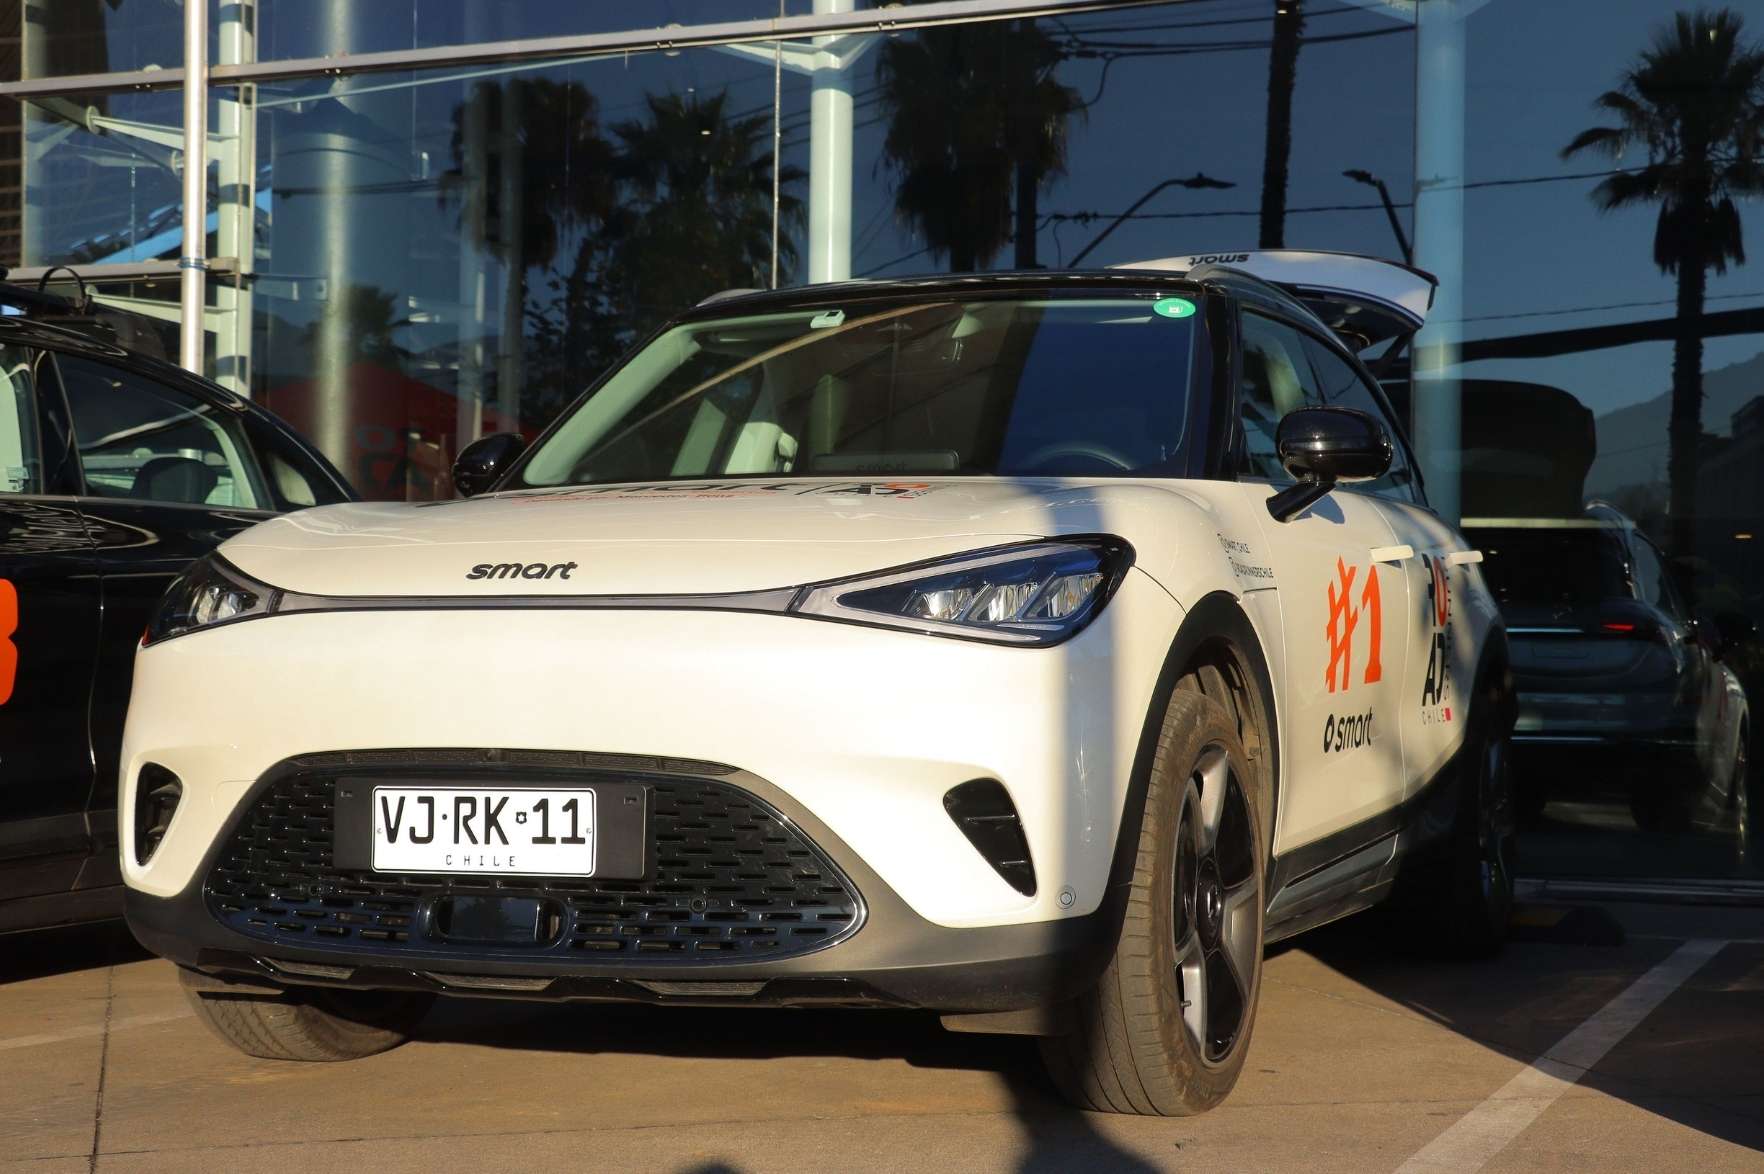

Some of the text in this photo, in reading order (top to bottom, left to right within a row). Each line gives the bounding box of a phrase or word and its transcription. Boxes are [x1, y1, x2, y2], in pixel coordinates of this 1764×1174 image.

[1189, 253, 1250, 266] smart
[465, 561, 579, 580] smart
[1326, 555, 1381, 693] #1
[1421, 706, 1446, 725] CHILE
[1334, 705, 1373, 753] smart
[445, 854, 516, 867] CHILE
